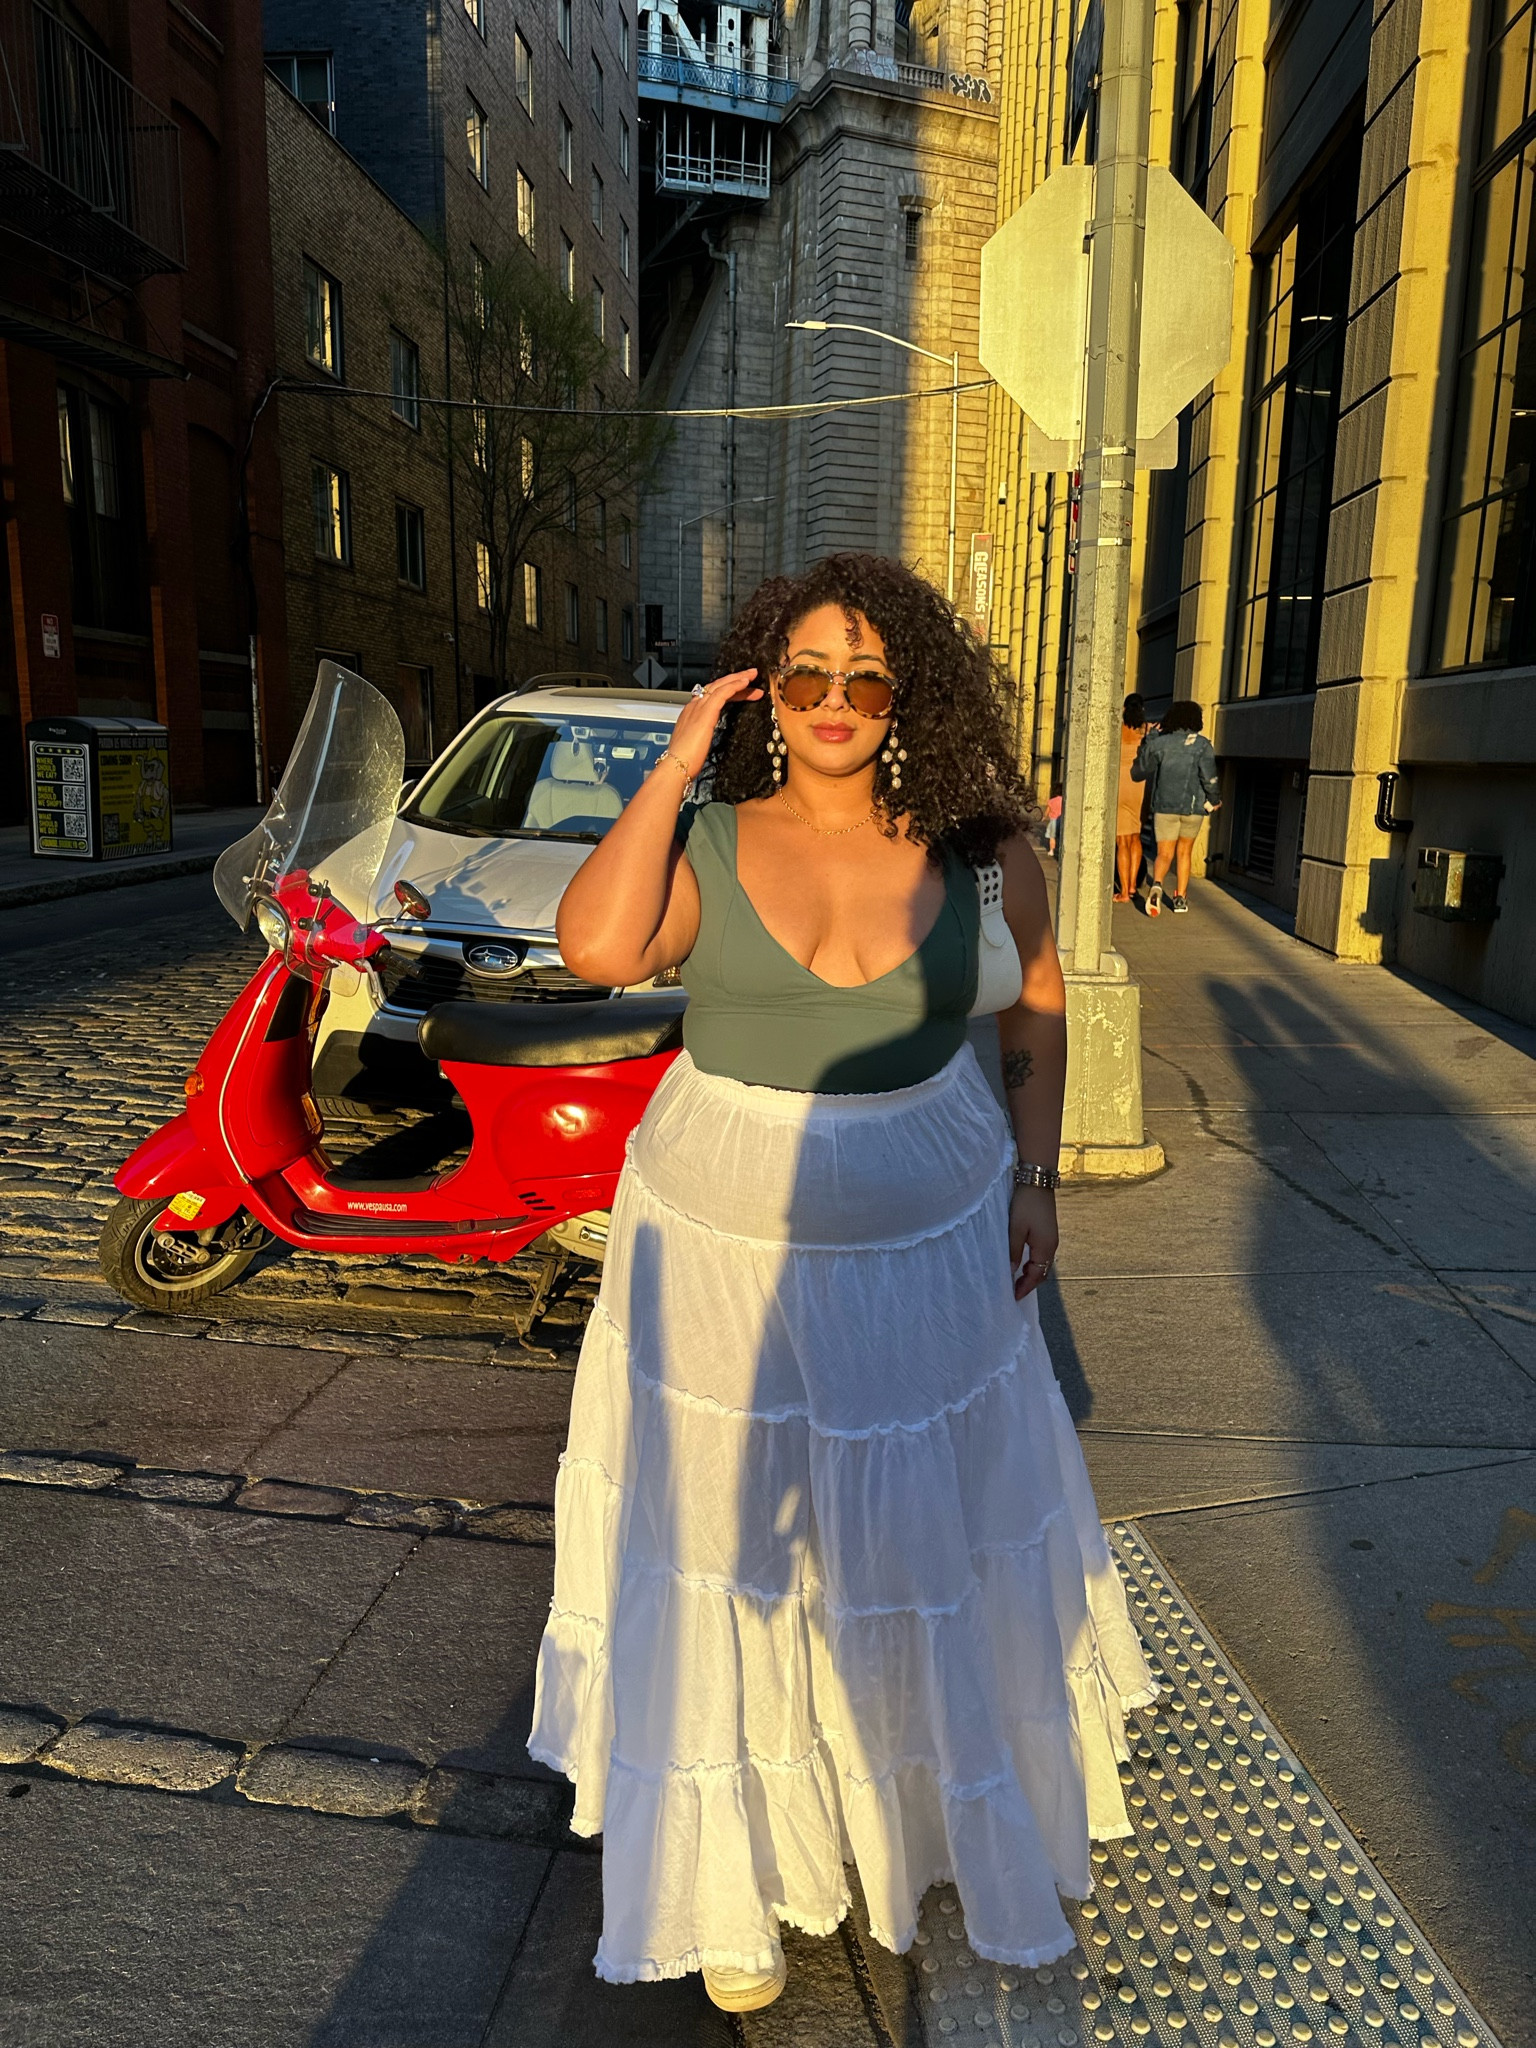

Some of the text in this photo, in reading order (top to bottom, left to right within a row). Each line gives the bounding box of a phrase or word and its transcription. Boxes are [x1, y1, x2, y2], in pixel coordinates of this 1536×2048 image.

[37, 771, 58, 779] WE EAT?
[46, 800, 62, 808] SHOP?
[39, 820, 58, 828] SHOULD
[347, 1201, 408, 1214] www.vespausa.com
